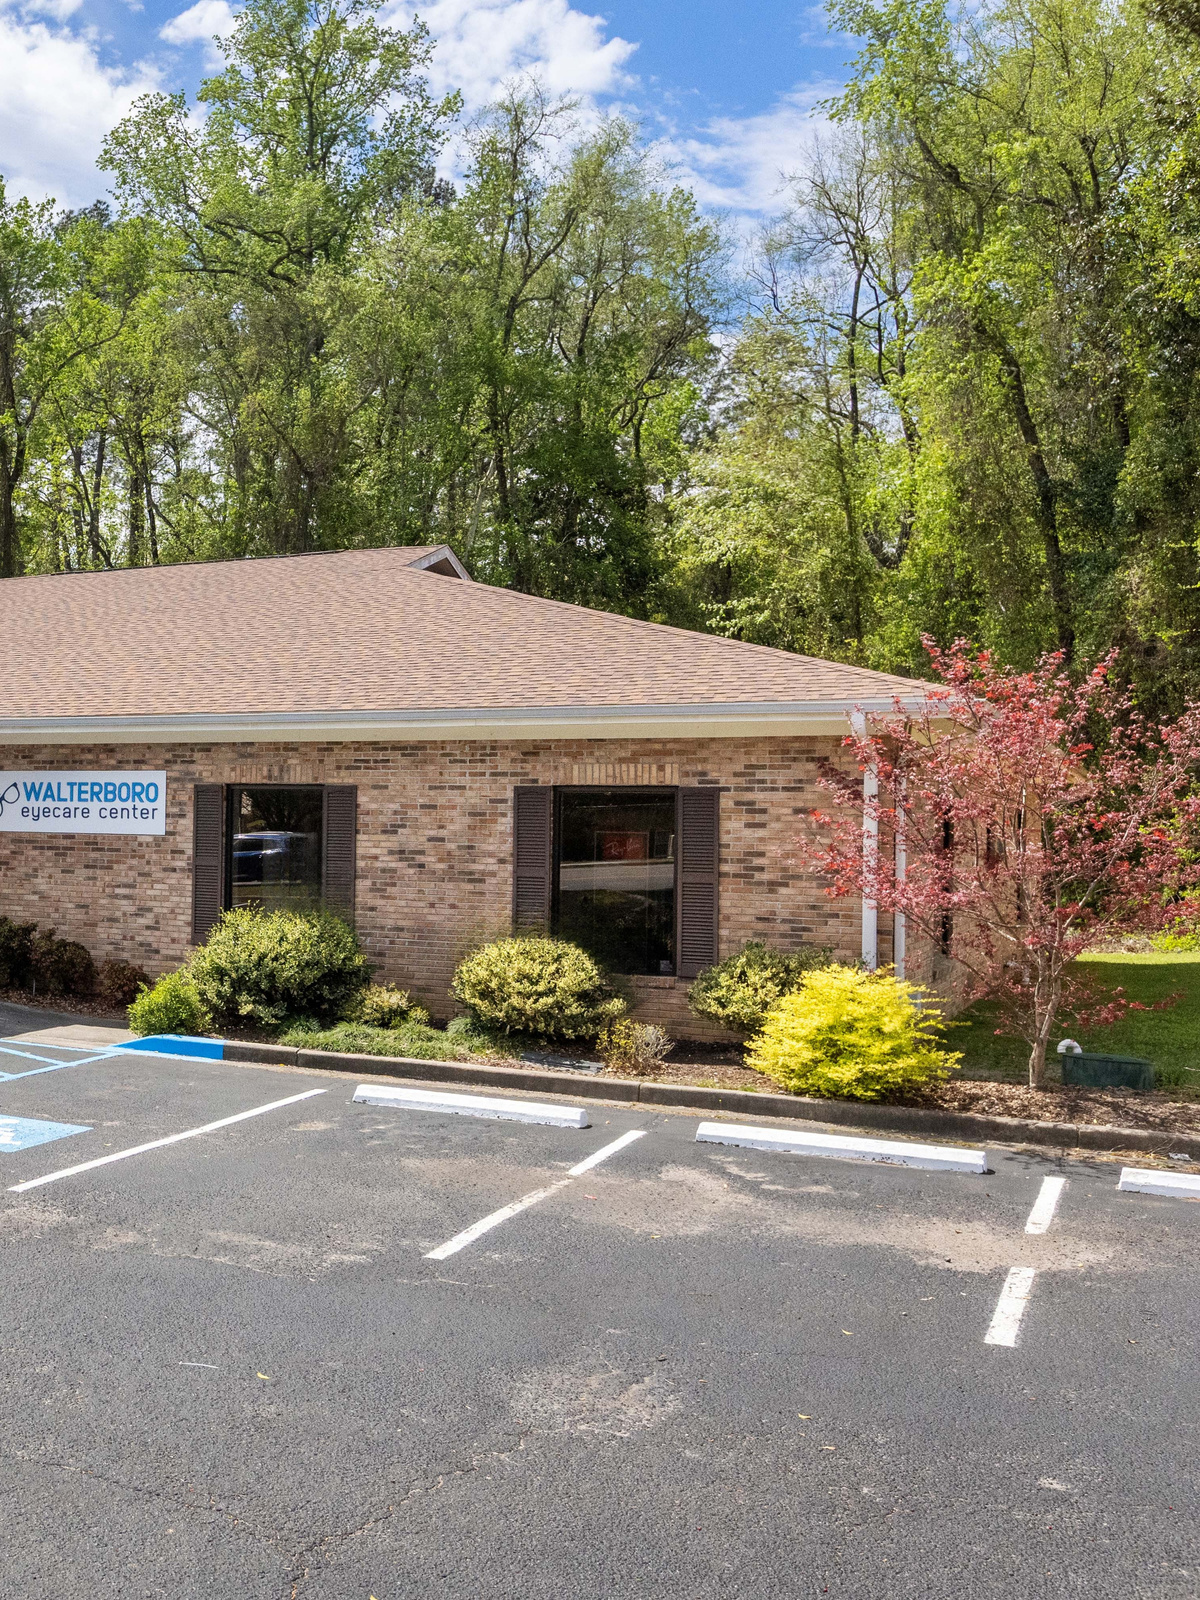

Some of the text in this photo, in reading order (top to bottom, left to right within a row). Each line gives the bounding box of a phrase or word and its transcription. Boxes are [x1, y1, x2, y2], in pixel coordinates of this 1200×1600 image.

[23, 781, 159, 803] WALTERBORO
[21, 804, 158, 821] eyecare center
